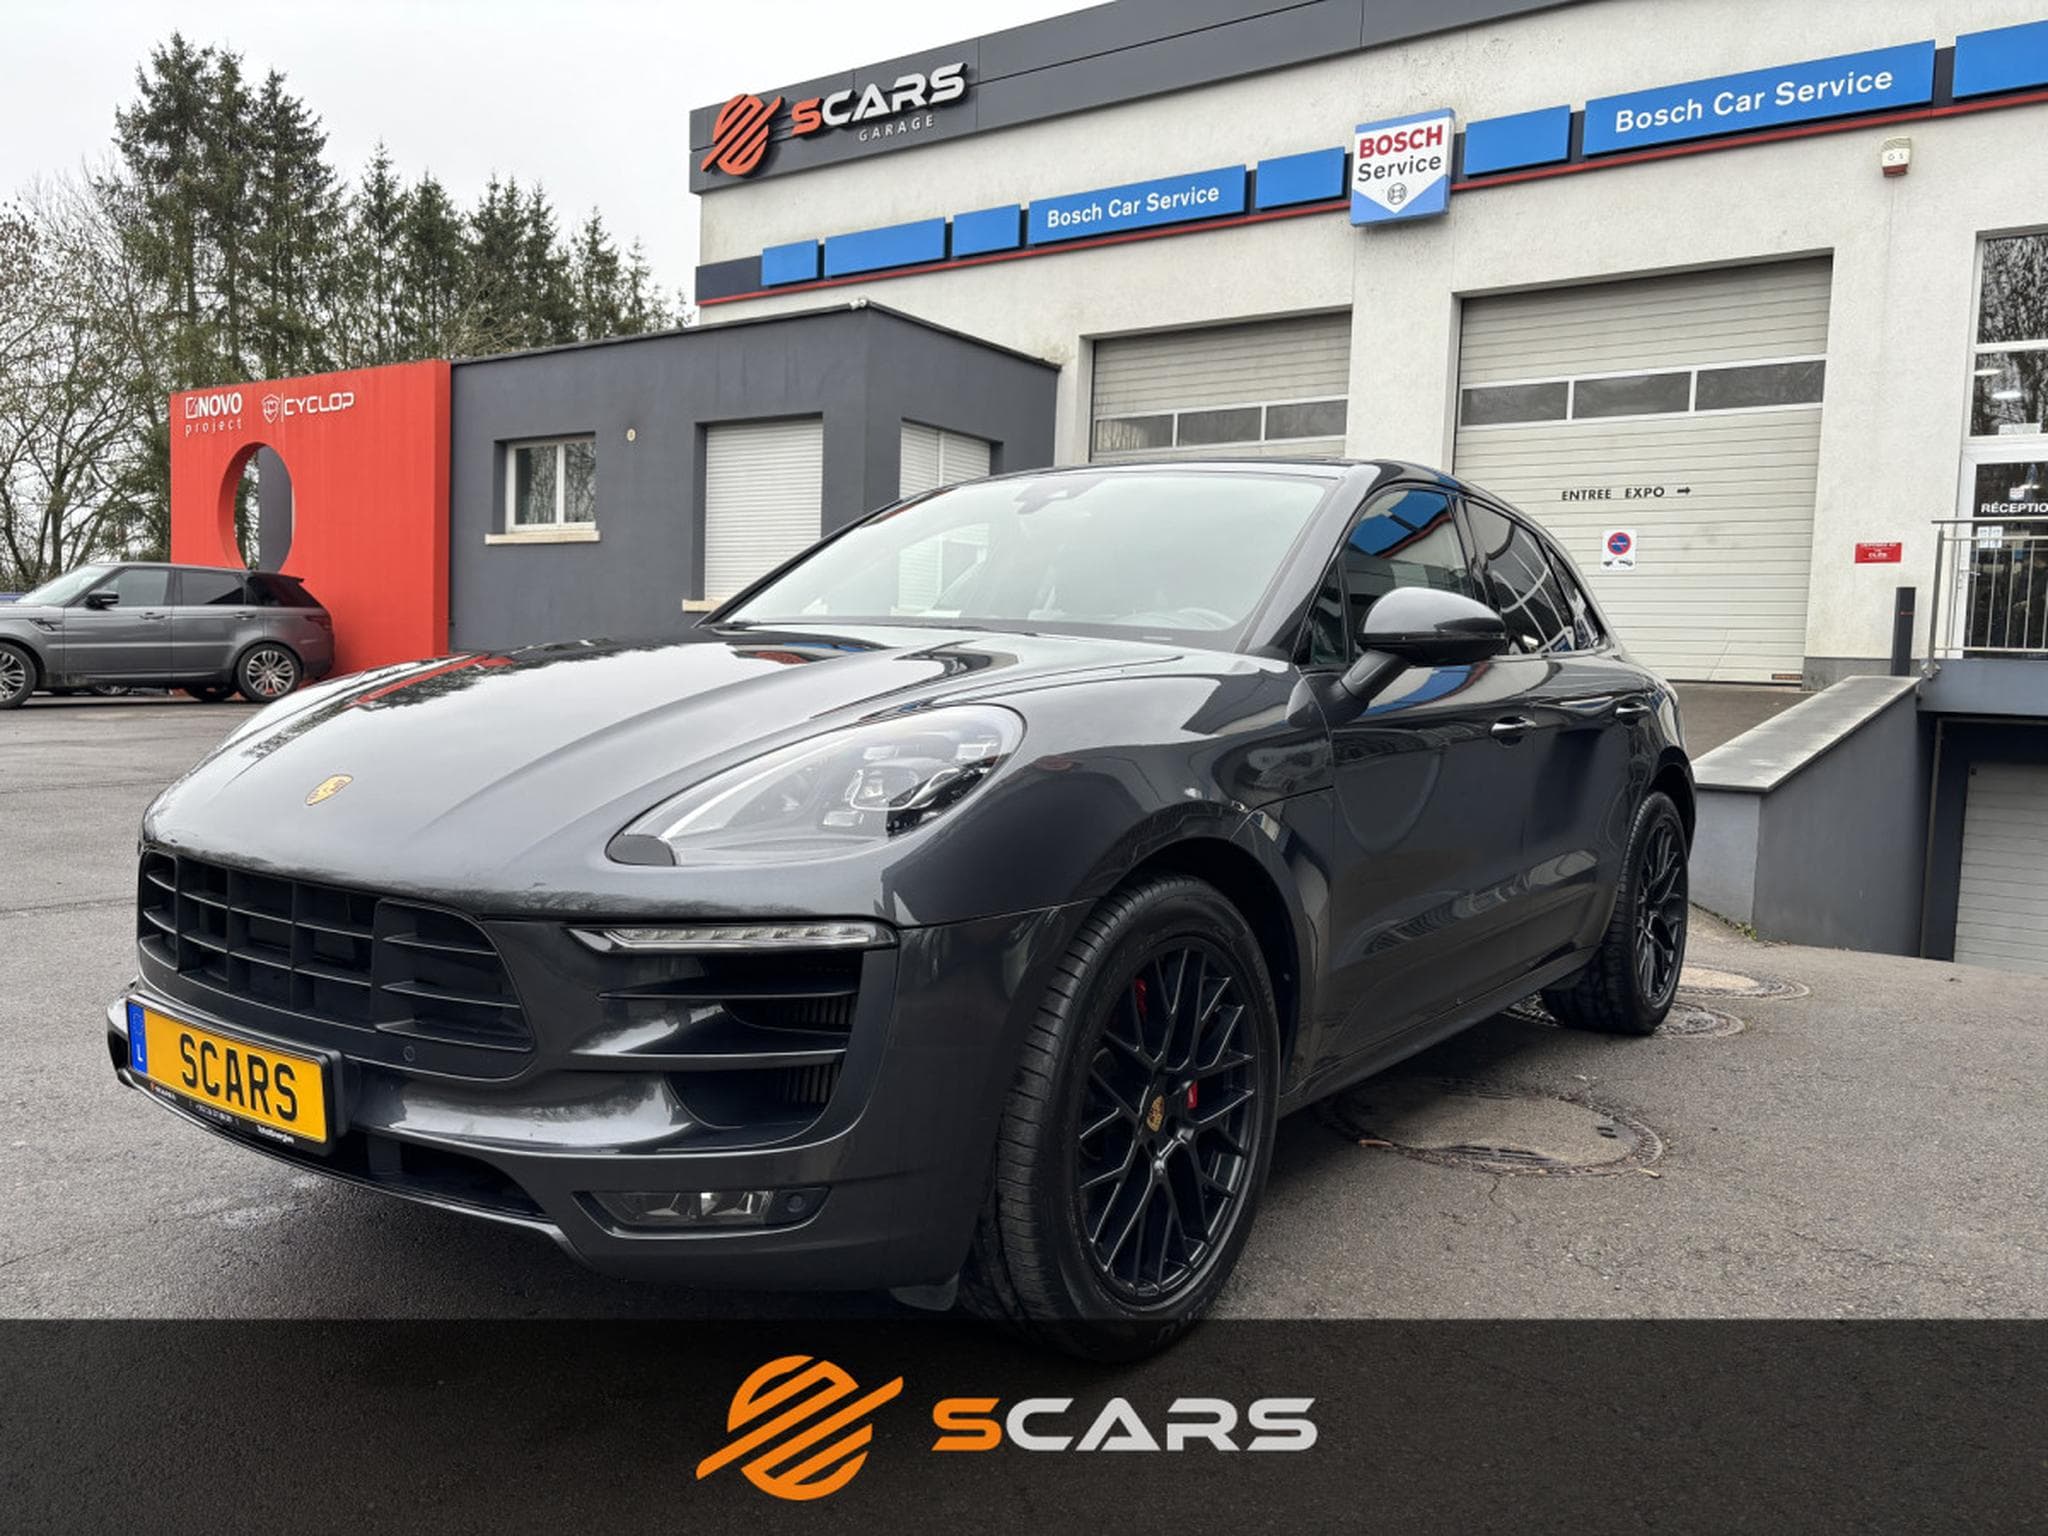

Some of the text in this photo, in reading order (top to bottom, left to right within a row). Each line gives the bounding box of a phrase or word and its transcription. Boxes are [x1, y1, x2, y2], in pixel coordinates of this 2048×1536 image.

[791, 62, 968, 137] SCARS
[1615, 70, 1894, 133] Bosch Car Service
[859, 114, 935, 142] GARAGE
[1358, 124, 1443, 159] BOSCH
[1357, 154, 1442, 183] Service
[1047, 184, 1219, 228] Bosch Car Service
[284, 392, 354, 416] CYCLOP
[185, 417, 242, 438] project
[1562, 486, 1665, 501] ENTREE EXPO
[179, 1033, 299, 1122] SCARS
